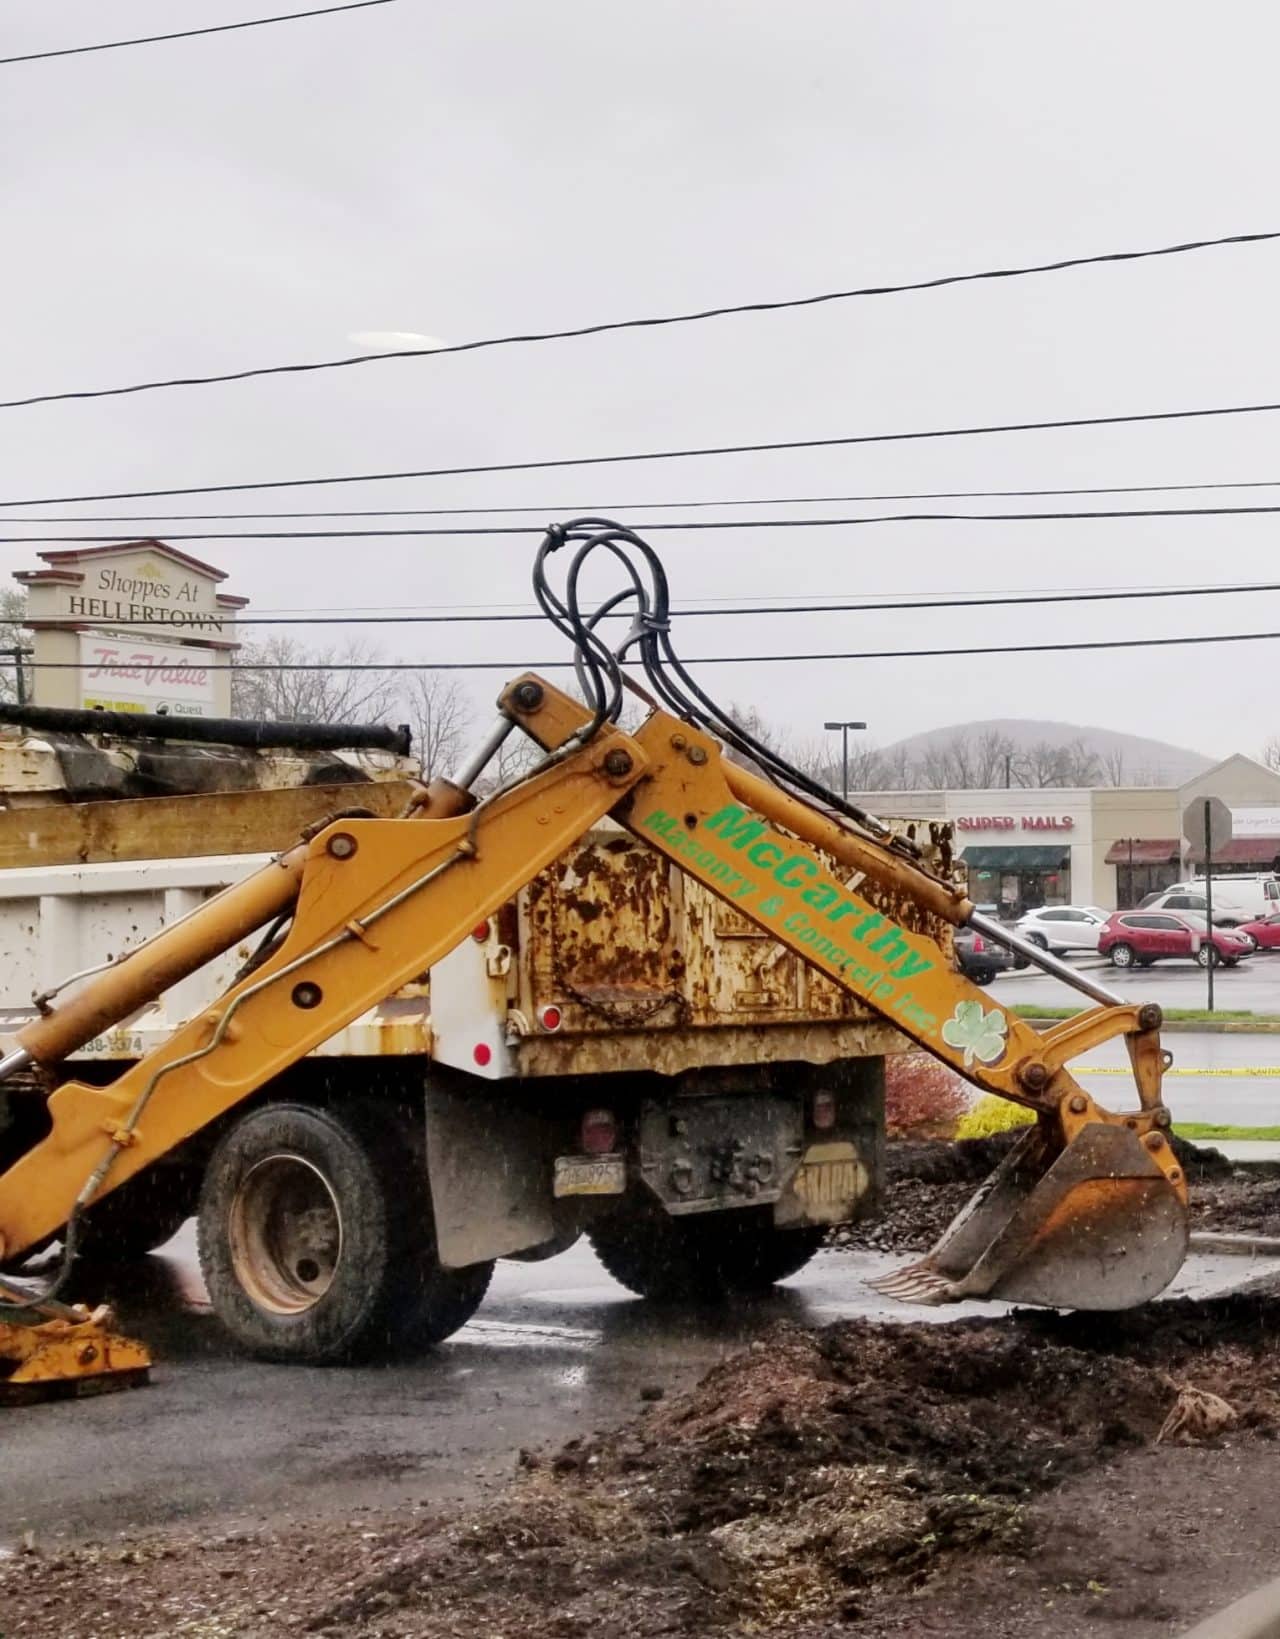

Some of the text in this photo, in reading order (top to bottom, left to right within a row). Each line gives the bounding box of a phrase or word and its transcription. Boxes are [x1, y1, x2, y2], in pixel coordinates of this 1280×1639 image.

[98, 569, 200, 602] Shoppes At
[69, 596, 224, 632] HELLERTOWN
[957, 816, 1074, 830] SUPER NAILS
[704, 803, 934, 979] McCarthy
[643, 809, 938, 1037] Masonry & Concrete Inc.
